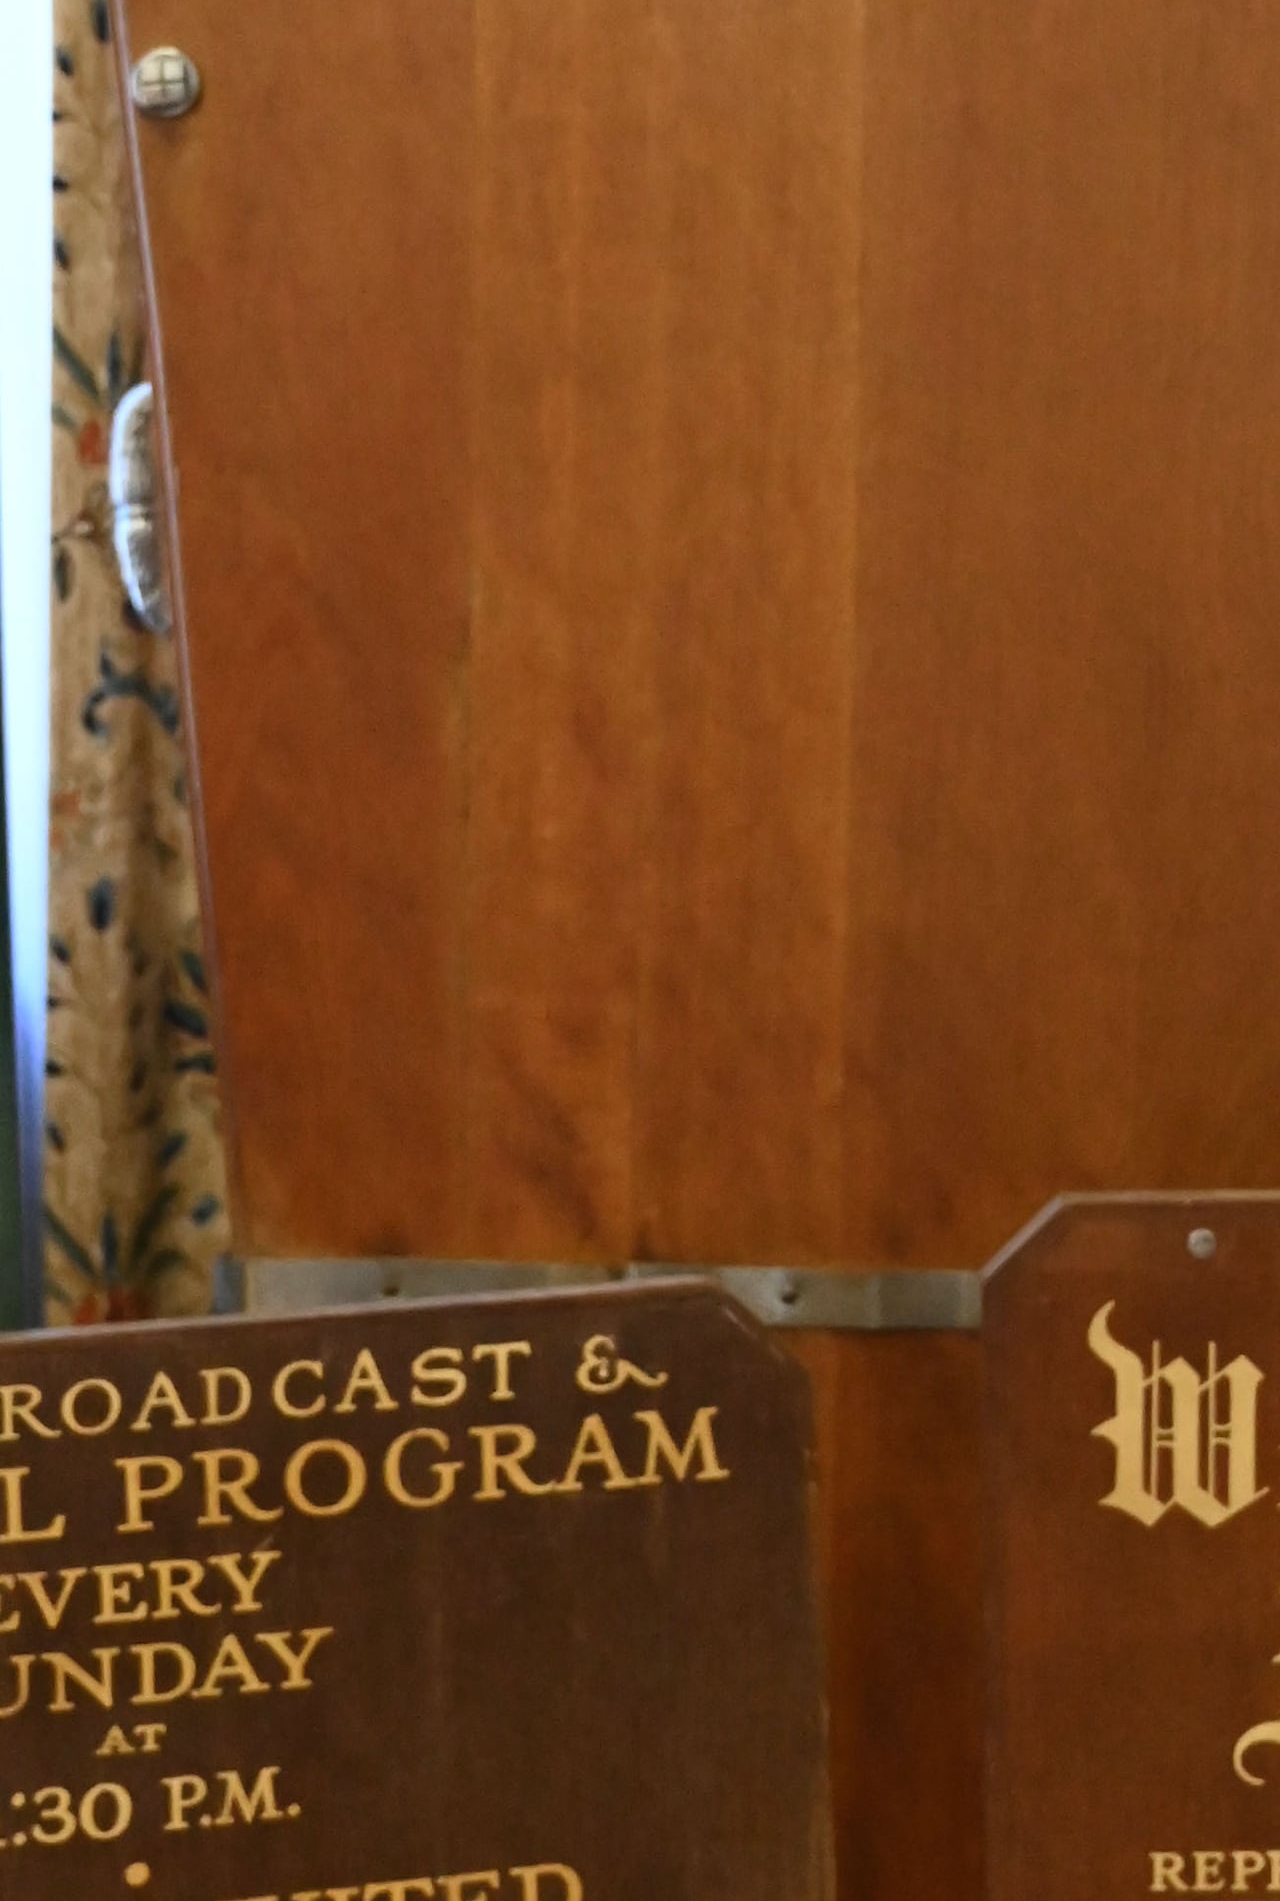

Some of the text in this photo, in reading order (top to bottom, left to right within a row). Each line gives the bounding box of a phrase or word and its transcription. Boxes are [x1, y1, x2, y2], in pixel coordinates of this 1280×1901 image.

[575, 1334, 669, 1394] &
[114, 1405, 731, 1534] PROGRAM
[95, 1722, 168, 1756] AT
[161, 1766, 302, 1835] P.M.
